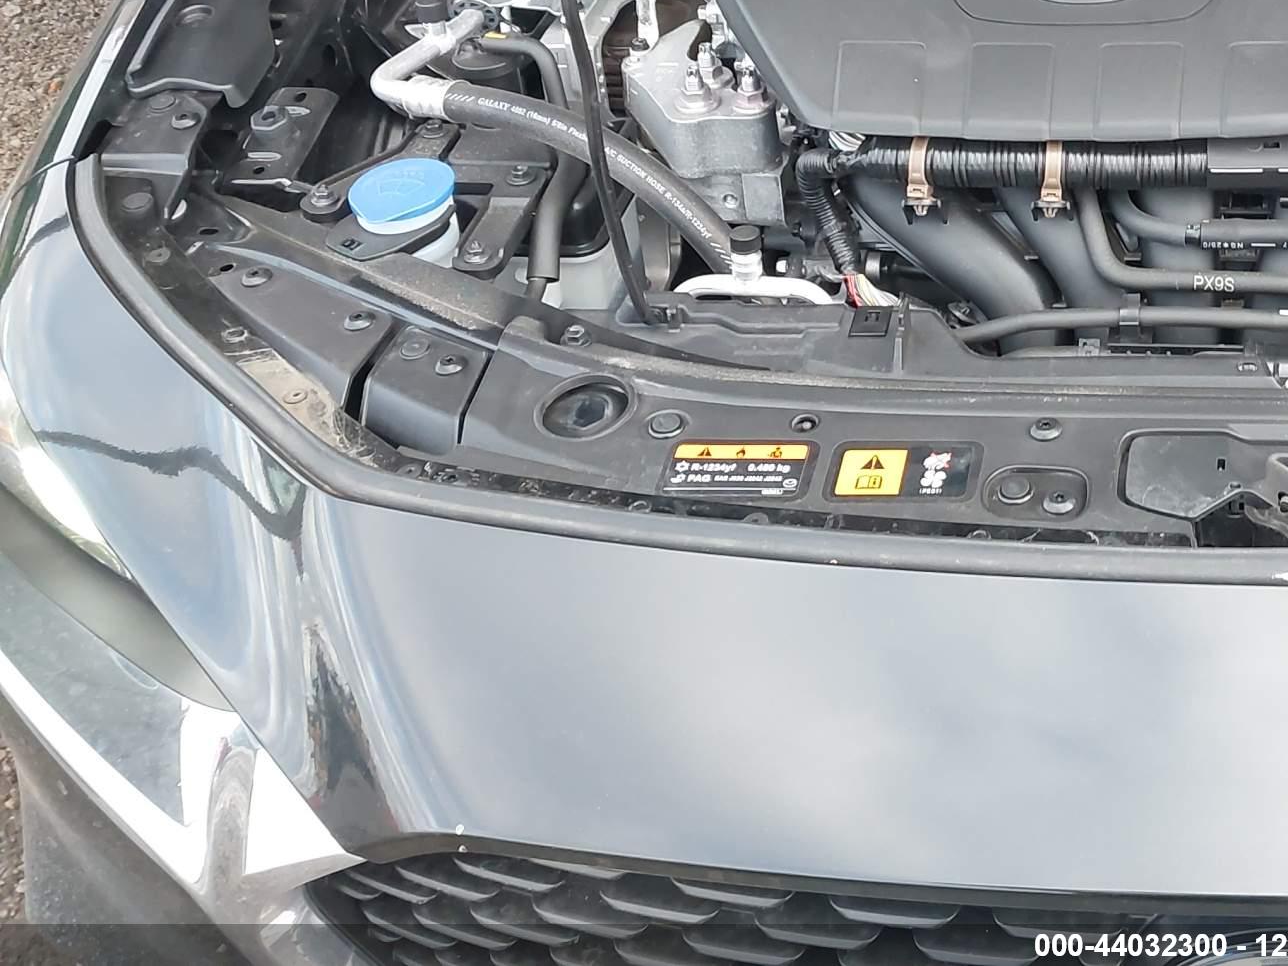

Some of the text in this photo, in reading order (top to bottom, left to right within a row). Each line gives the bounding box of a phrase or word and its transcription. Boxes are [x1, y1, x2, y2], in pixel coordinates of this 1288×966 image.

[477, 97, 512, 111] GALAXY
[616, 153, 647, 179] SUCTION
[645, 174, 666, 196] HOSE
[1193, 274, 1236, 294] PX9S
[776, 463, 792, 474] kg
[686, 474, 712, 483] PAG
